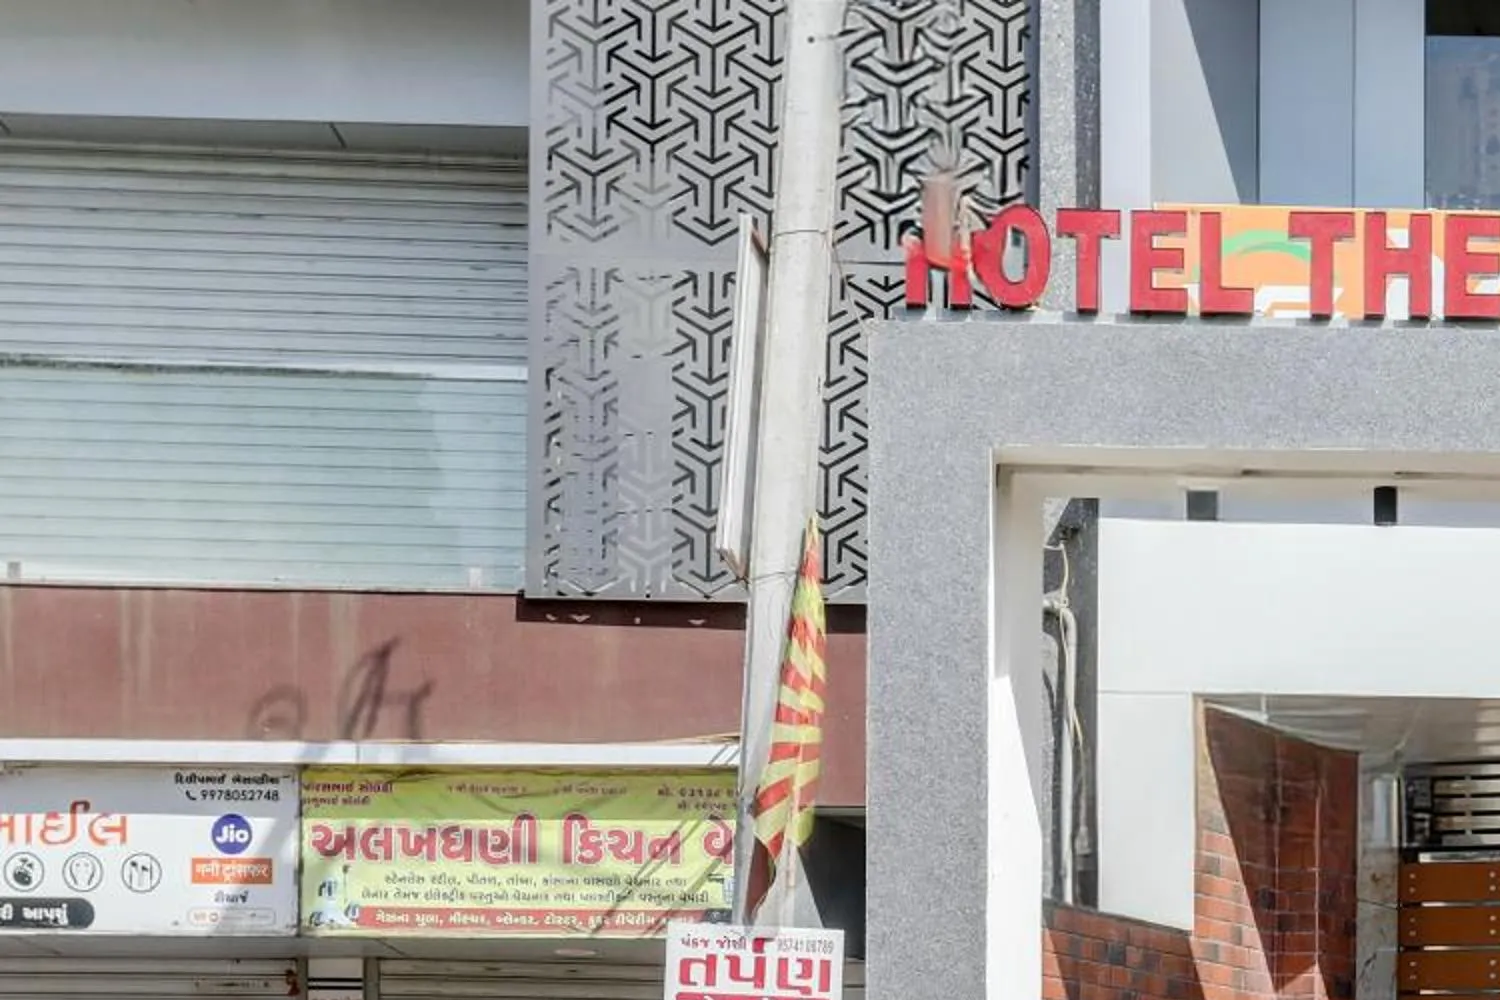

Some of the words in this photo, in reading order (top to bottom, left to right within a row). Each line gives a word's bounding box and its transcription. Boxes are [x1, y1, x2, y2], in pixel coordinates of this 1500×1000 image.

[199, 789, 280, 802] 9978052748
[215, 823, 249, 845] Jio
[562, 812, 682, 866] કિચન
[703, 812, 733, 866] વે
[679, 937, 832, 996] તર્પણ
